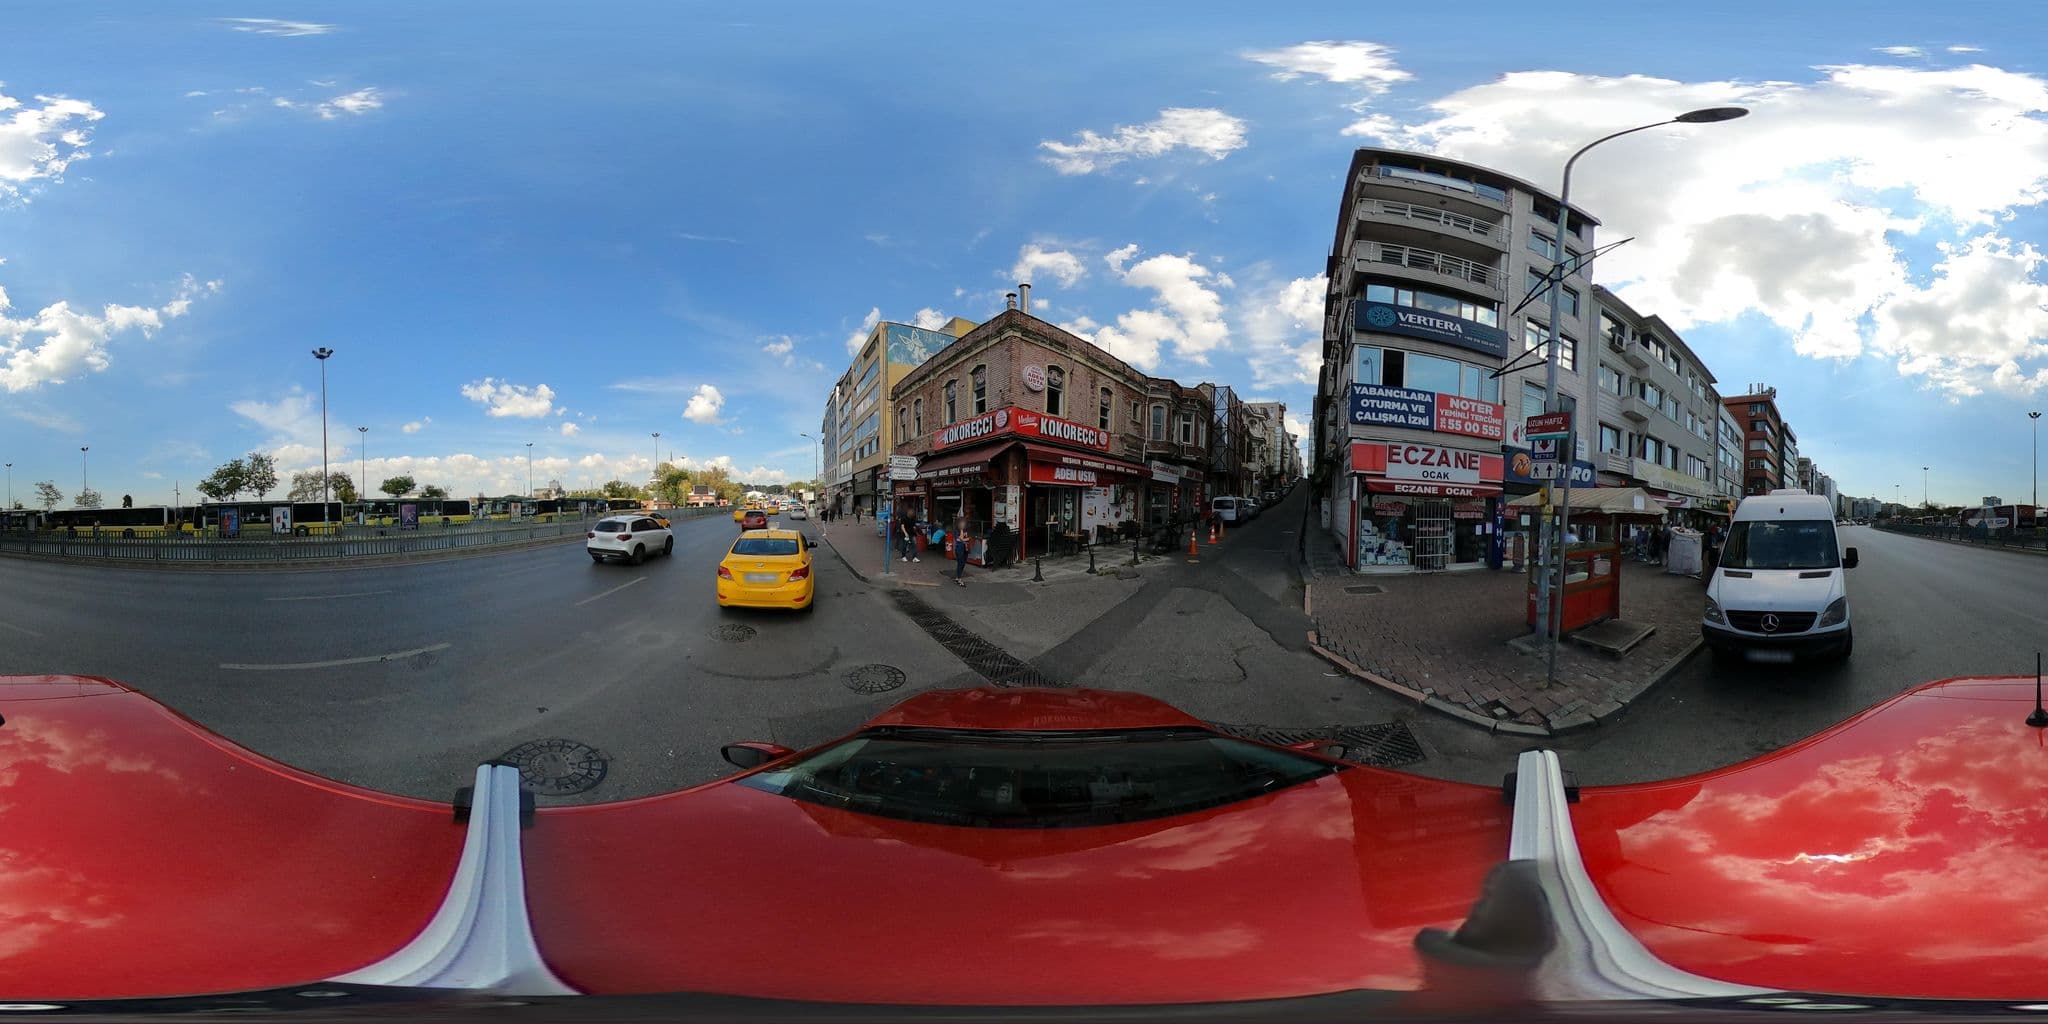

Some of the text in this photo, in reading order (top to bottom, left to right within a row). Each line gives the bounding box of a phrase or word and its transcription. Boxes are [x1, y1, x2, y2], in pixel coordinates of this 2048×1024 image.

[1398, 312, 1463, 334] VERTERA
[1028, 372, 1044, 381] ADEM
[1353, 386, 1432, 403] YABANCILARA
[1360, 399, 1426, 413] OTURMA VE
[1439, 408, 1470, 419] YEMİNLİ
[1450, 398, 1493, 415] NOTER
[1356, 411, 1429, 426] ÇALIŞMA İZNİ
[1448, 420, 1462, 431] 55
[1464, 422, 1479, 433] 00
[1481, 425, 1501, 437] 555
[1387, 444, 1479, 470] ECZANE
[1054, 467, 1097, 482] ADEM USTA
[1422, 470, 1450, 480] OCAK
[1394, 484, 1473, 496] ECZANE OCAK
